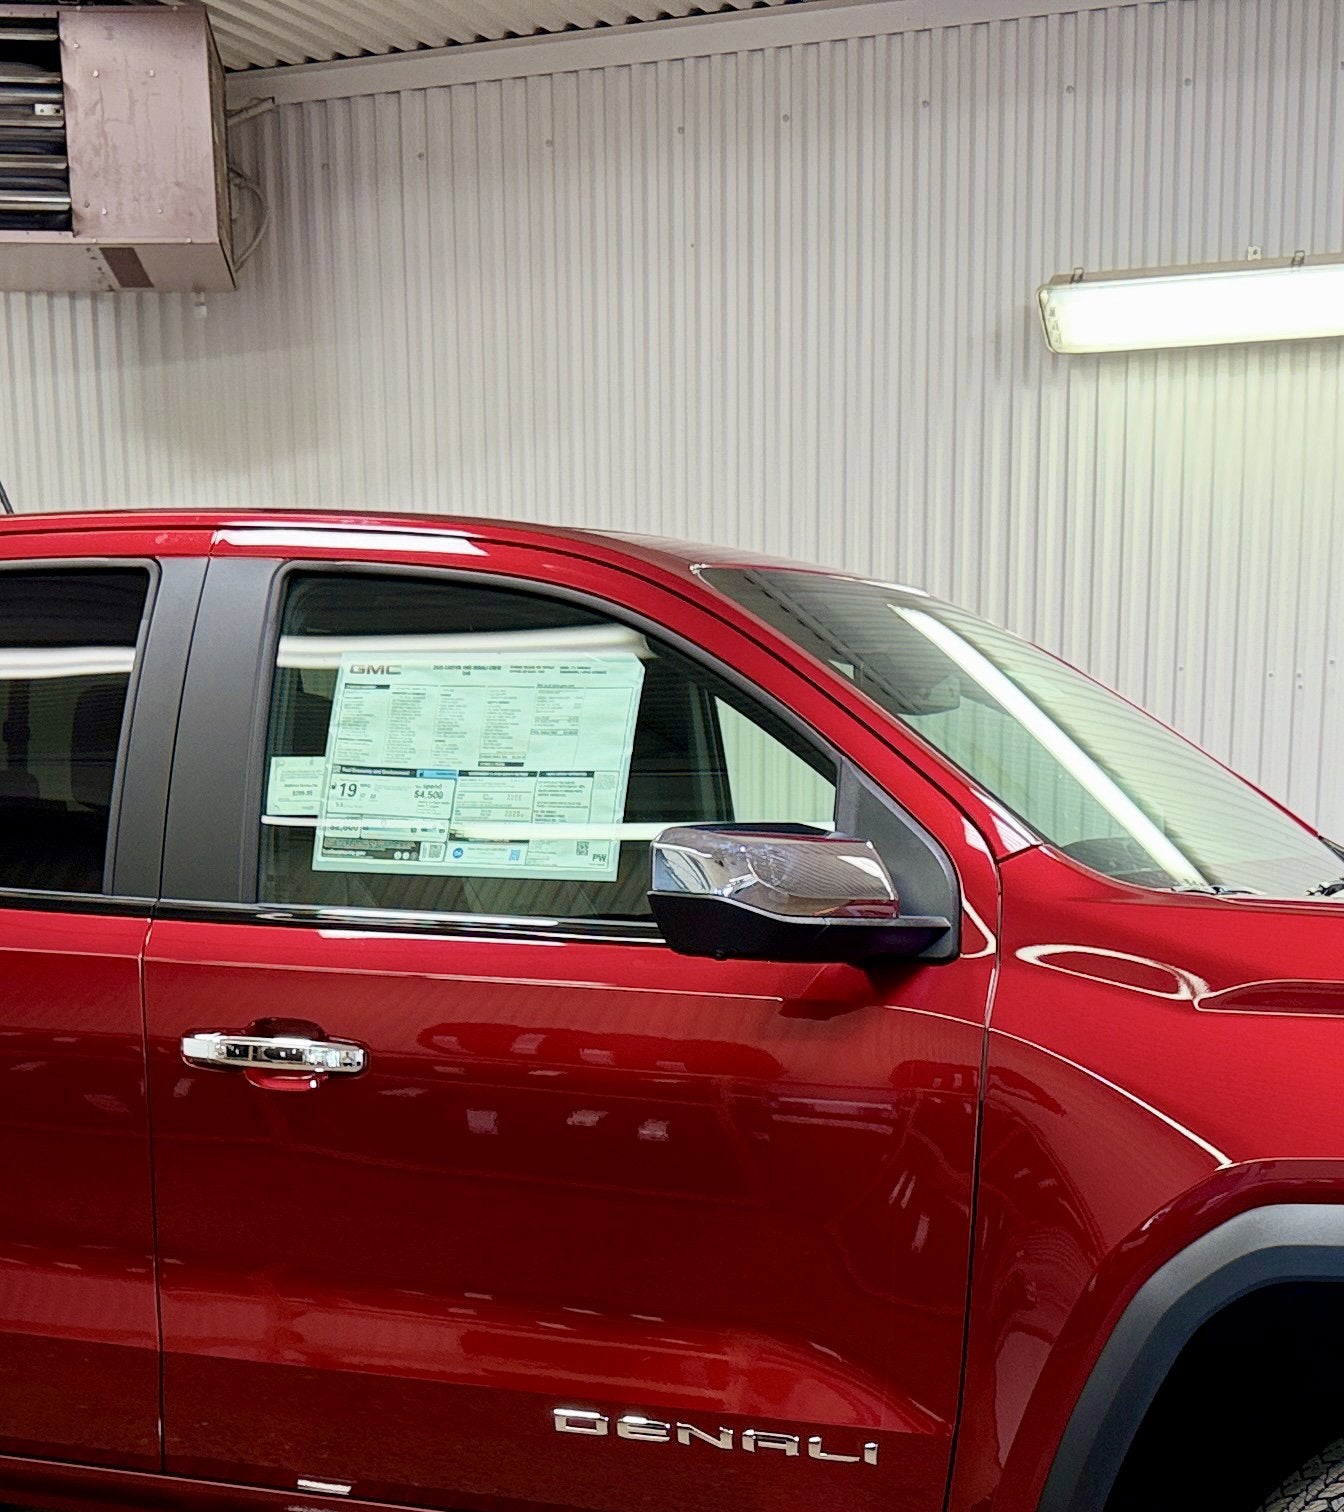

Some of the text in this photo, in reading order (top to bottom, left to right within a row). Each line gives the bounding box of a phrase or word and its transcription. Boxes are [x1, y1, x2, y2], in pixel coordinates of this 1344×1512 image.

[349, 664, 402, 675] GMC
[339, 783, 357, 798] 19
[553, 1407, 879, 1466] DENALI
